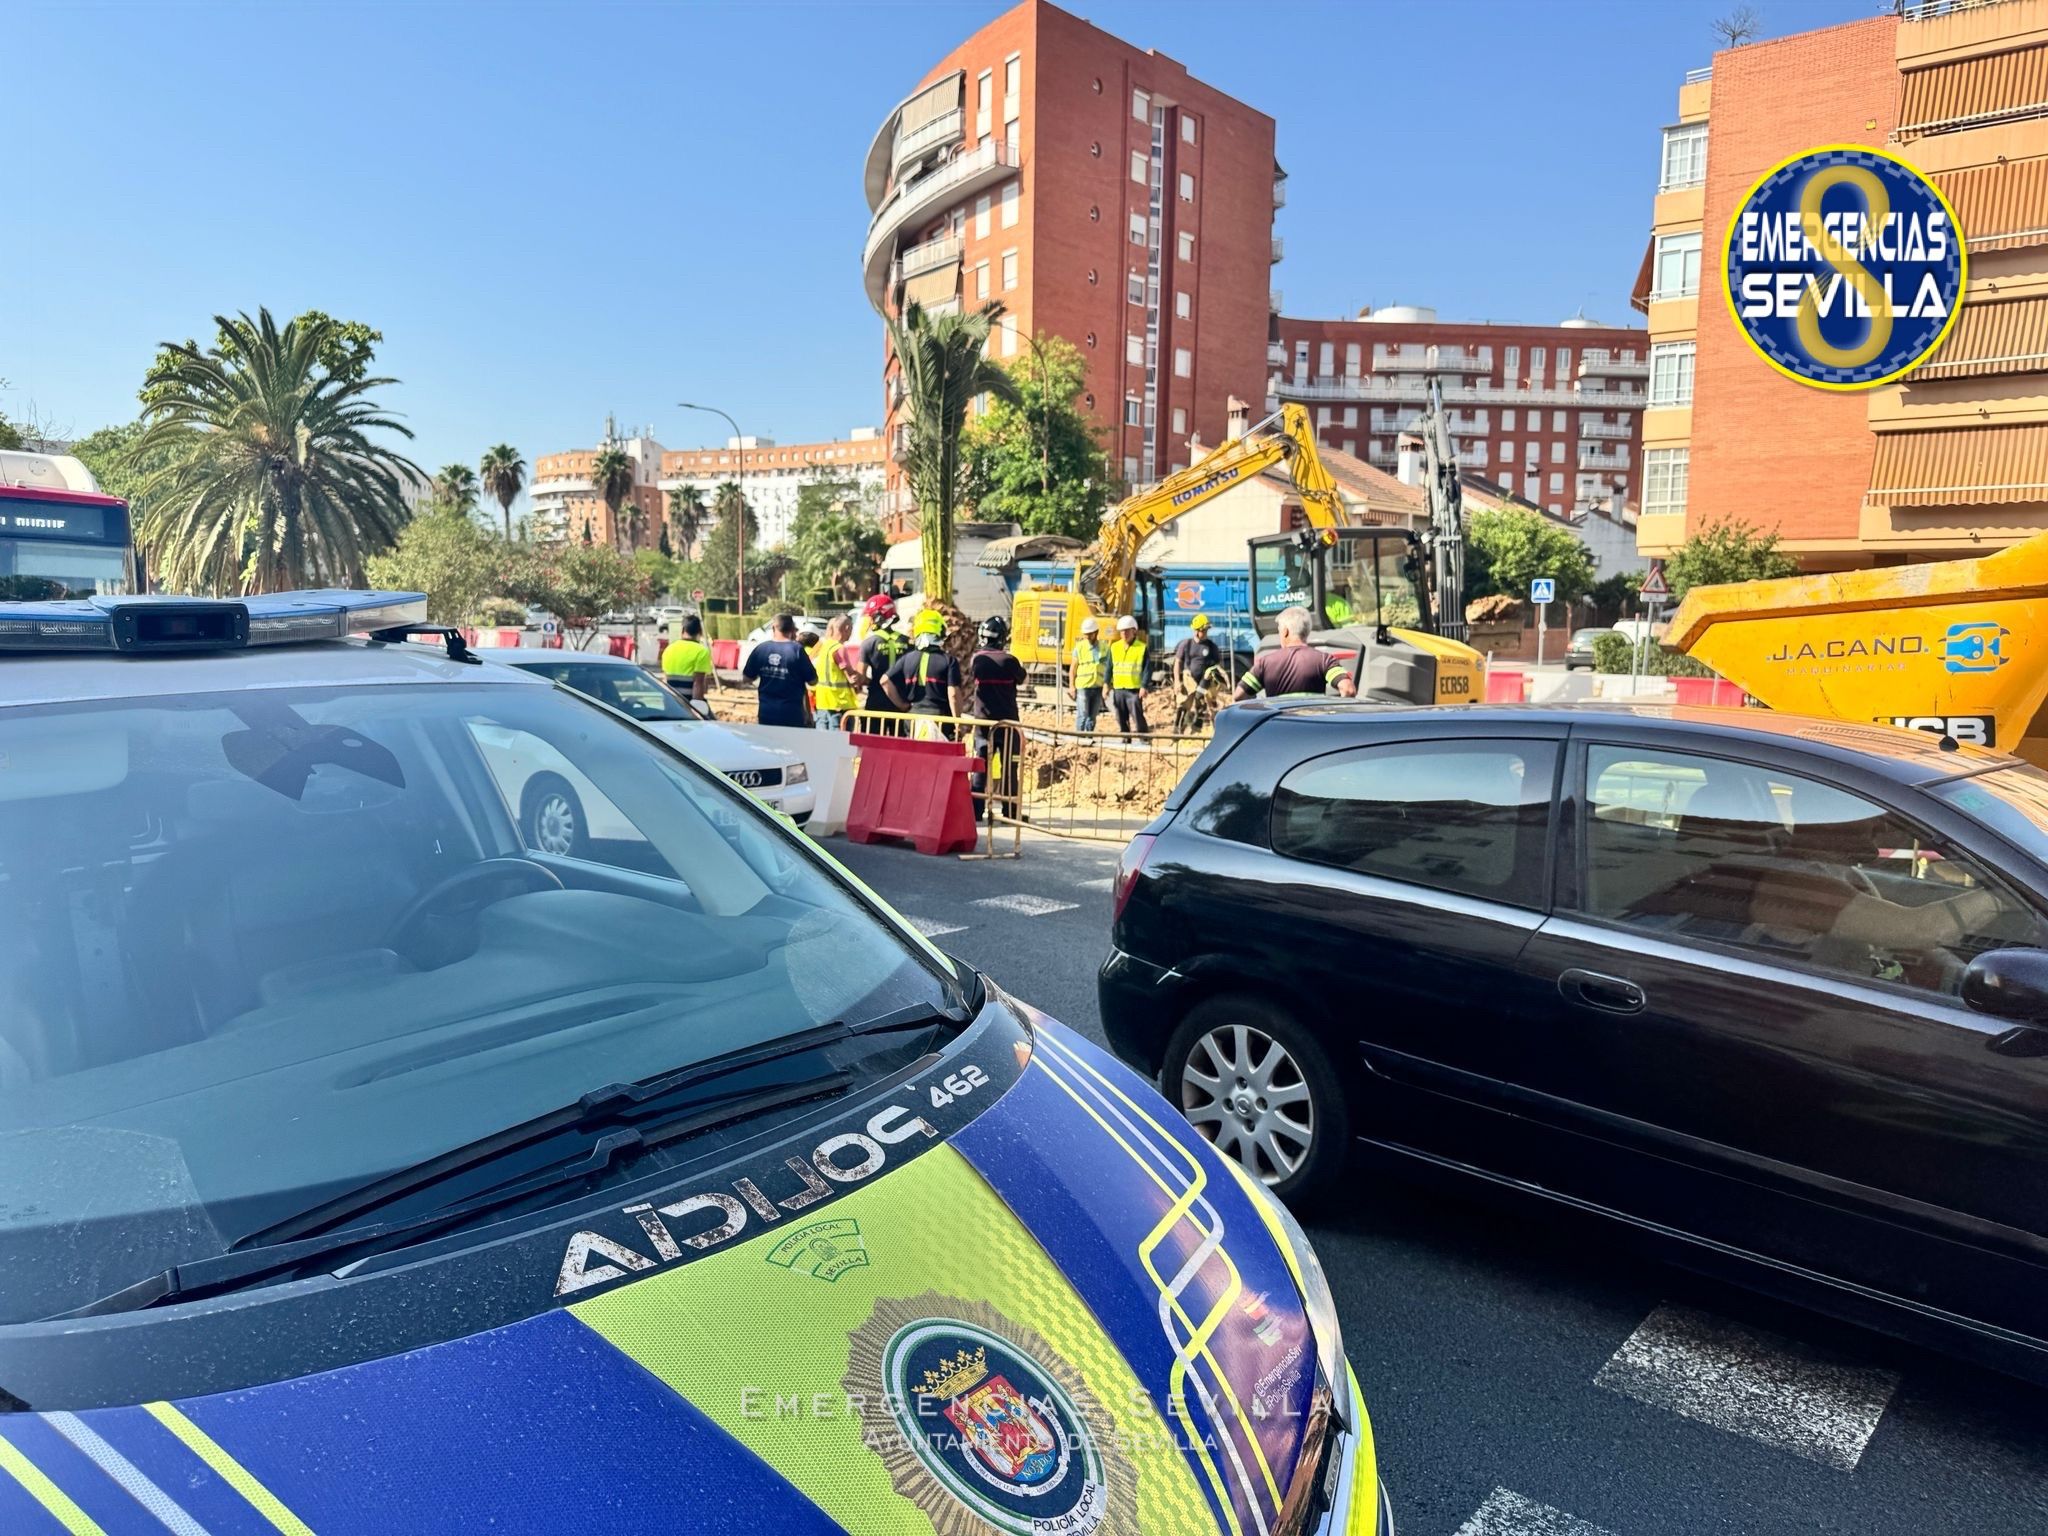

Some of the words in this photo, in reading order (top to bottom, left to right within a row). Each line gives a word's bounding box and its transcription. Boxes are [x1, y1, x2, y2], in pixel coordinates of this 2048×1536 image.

[1172, 467, 1239, 507] KOMATSU
[929, 1064, 990, 1109] 462
[810, 1223, 841, 1235] LOCAL
[825, 1256, 862, 1276] SEVILLA
[1033, 1514, 1079, 1532] POLICÍA
[1076, 1483, 1096, 1519] LOCAL
